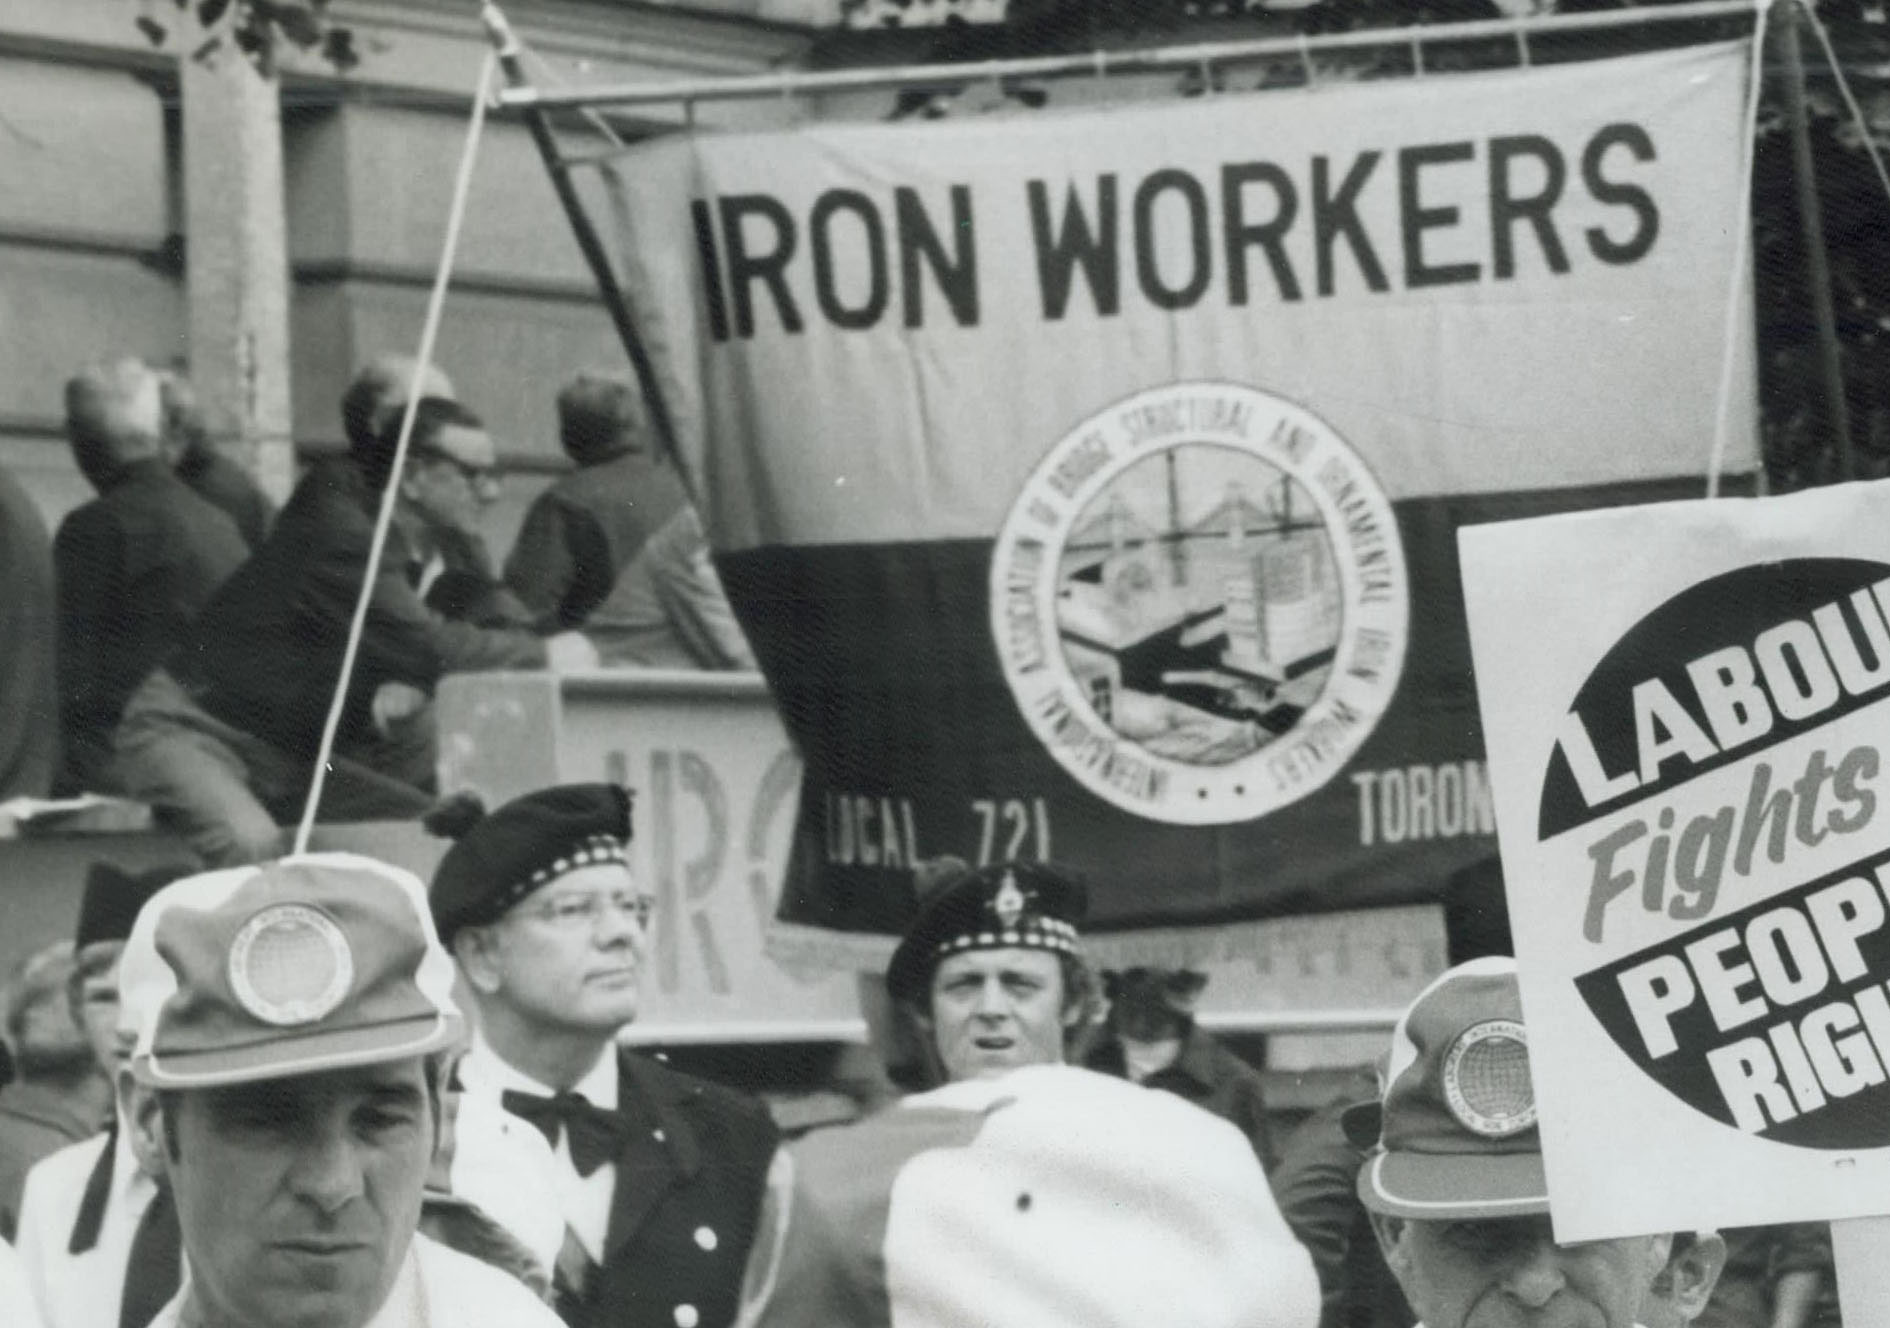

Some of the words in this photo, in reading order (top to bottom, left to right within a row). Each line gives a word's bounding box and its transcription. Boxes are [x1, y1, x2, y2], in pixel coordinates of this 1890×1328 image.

[690, 183, 979, 343] IRON
[1026, 121, 1660, 321] WORKERS
[1120, 398, 1253, 446] STRUCTURAL
[1270, 417, 1319, 466] AND
[1047, 429, 1113, 500] BRIDGE
[1026, 496, 1060, 526] OF
[1313, 455, 1391, 606] ORNAMENTAL
[1006, 537, 1046, 676] ASSOCIATION
[1347, 627, 1392, 684] IRON
[972, 797, 1051, 867] 721
[1582, 744, 1880, 944] Fights
